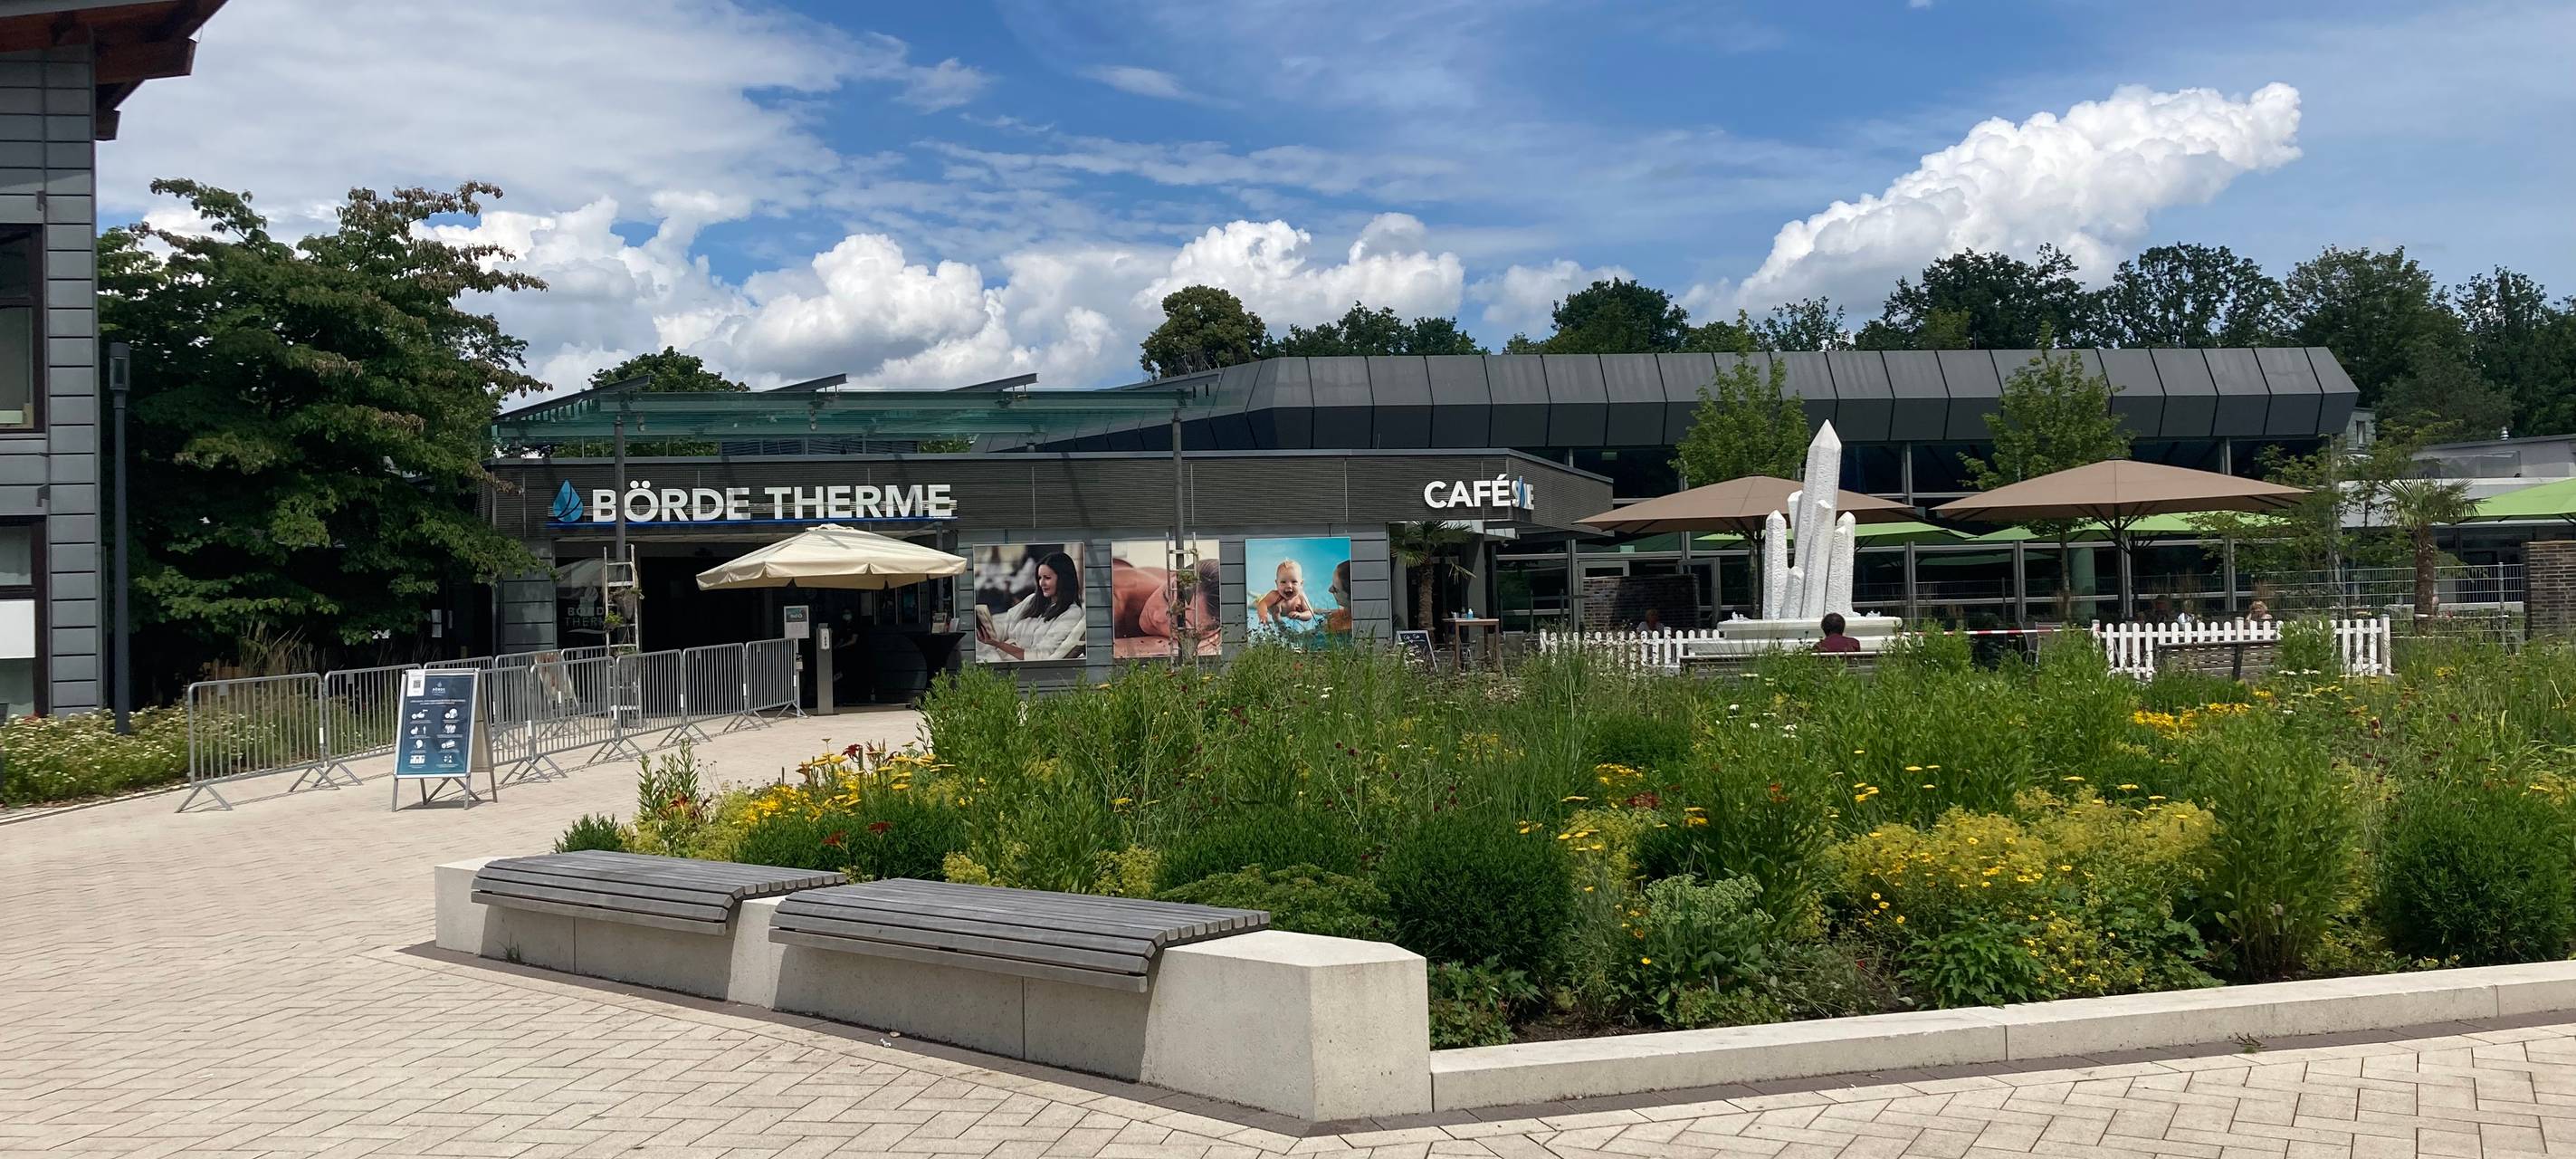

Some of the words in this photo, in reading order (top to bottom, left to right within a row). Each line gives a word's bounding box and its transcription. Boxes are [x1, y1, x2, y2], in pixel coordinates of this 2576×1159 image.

[592, 480, 751, 522] BÖRDE
[764, 484, 952, 520] THERME
[1424, 474, 1511, 509] CAFÉ
